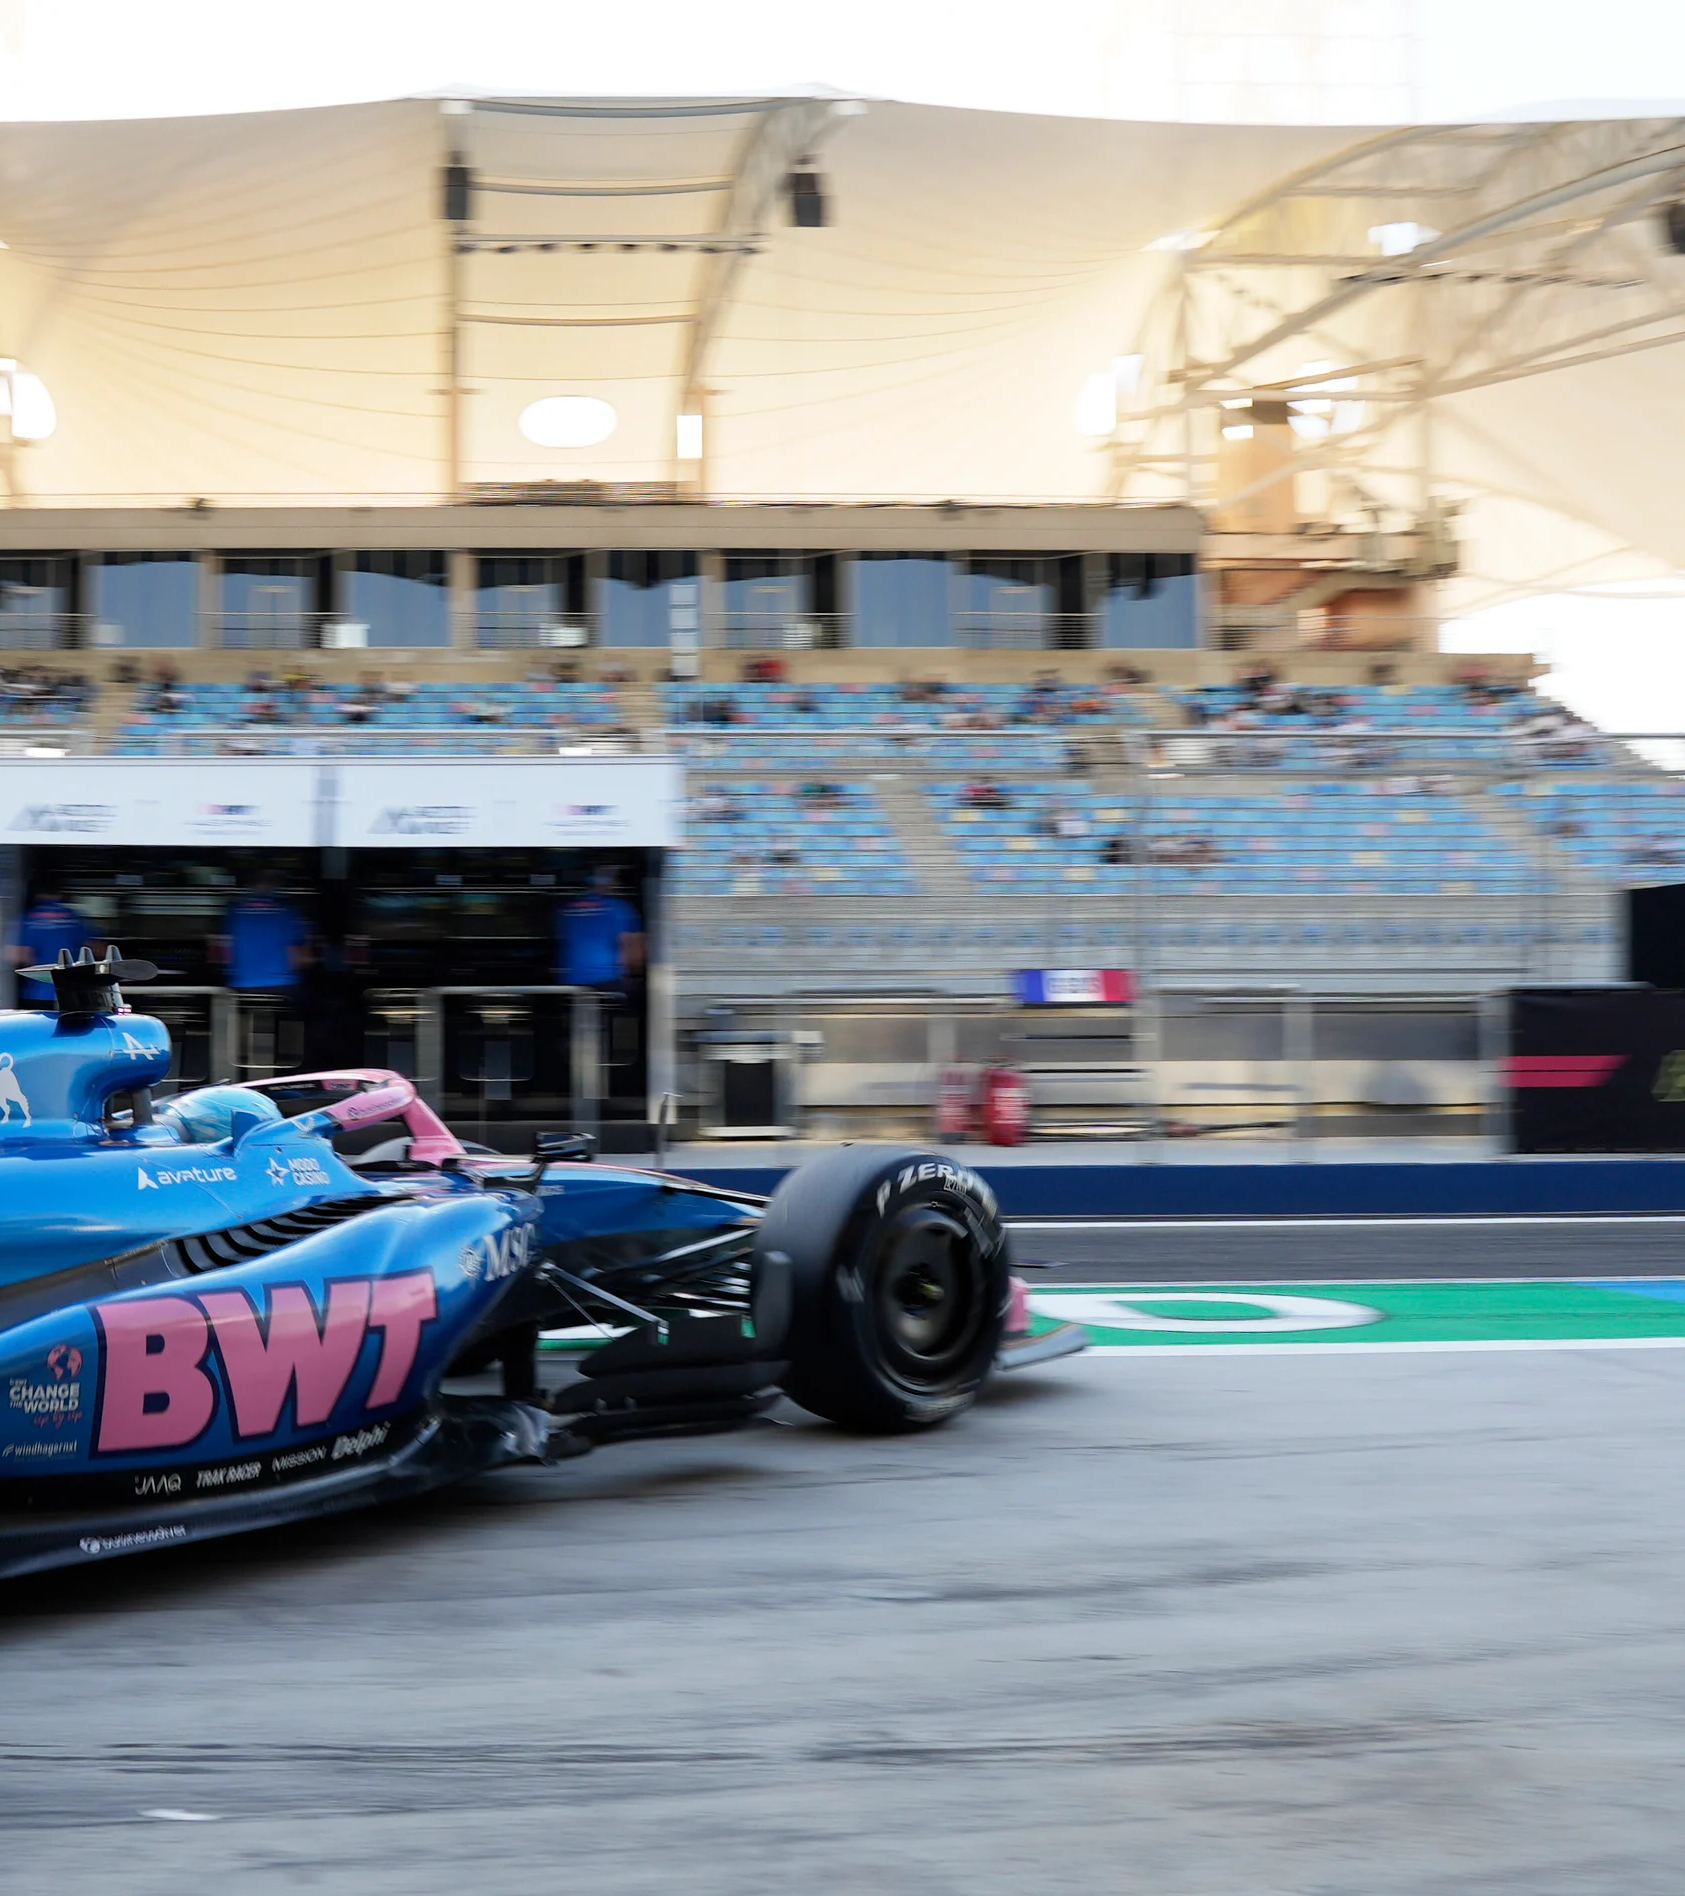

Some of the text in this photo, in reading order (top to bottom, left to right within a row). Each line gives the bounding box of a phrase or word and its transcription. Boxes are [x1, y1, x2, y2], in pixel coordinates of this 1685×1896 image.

[157, 1166, 238, 1185] avature
[292, 1171, 331, 1186] CASINO
[95, 1272, 437, 1453] BWT
[9, 1383, 81, 1400] CHANGE
[23, 1399, 79, 1414] WORLD
[331, 1421, 392, 1460] Delphi
[272, 1446, 327, 1472] MISSION
